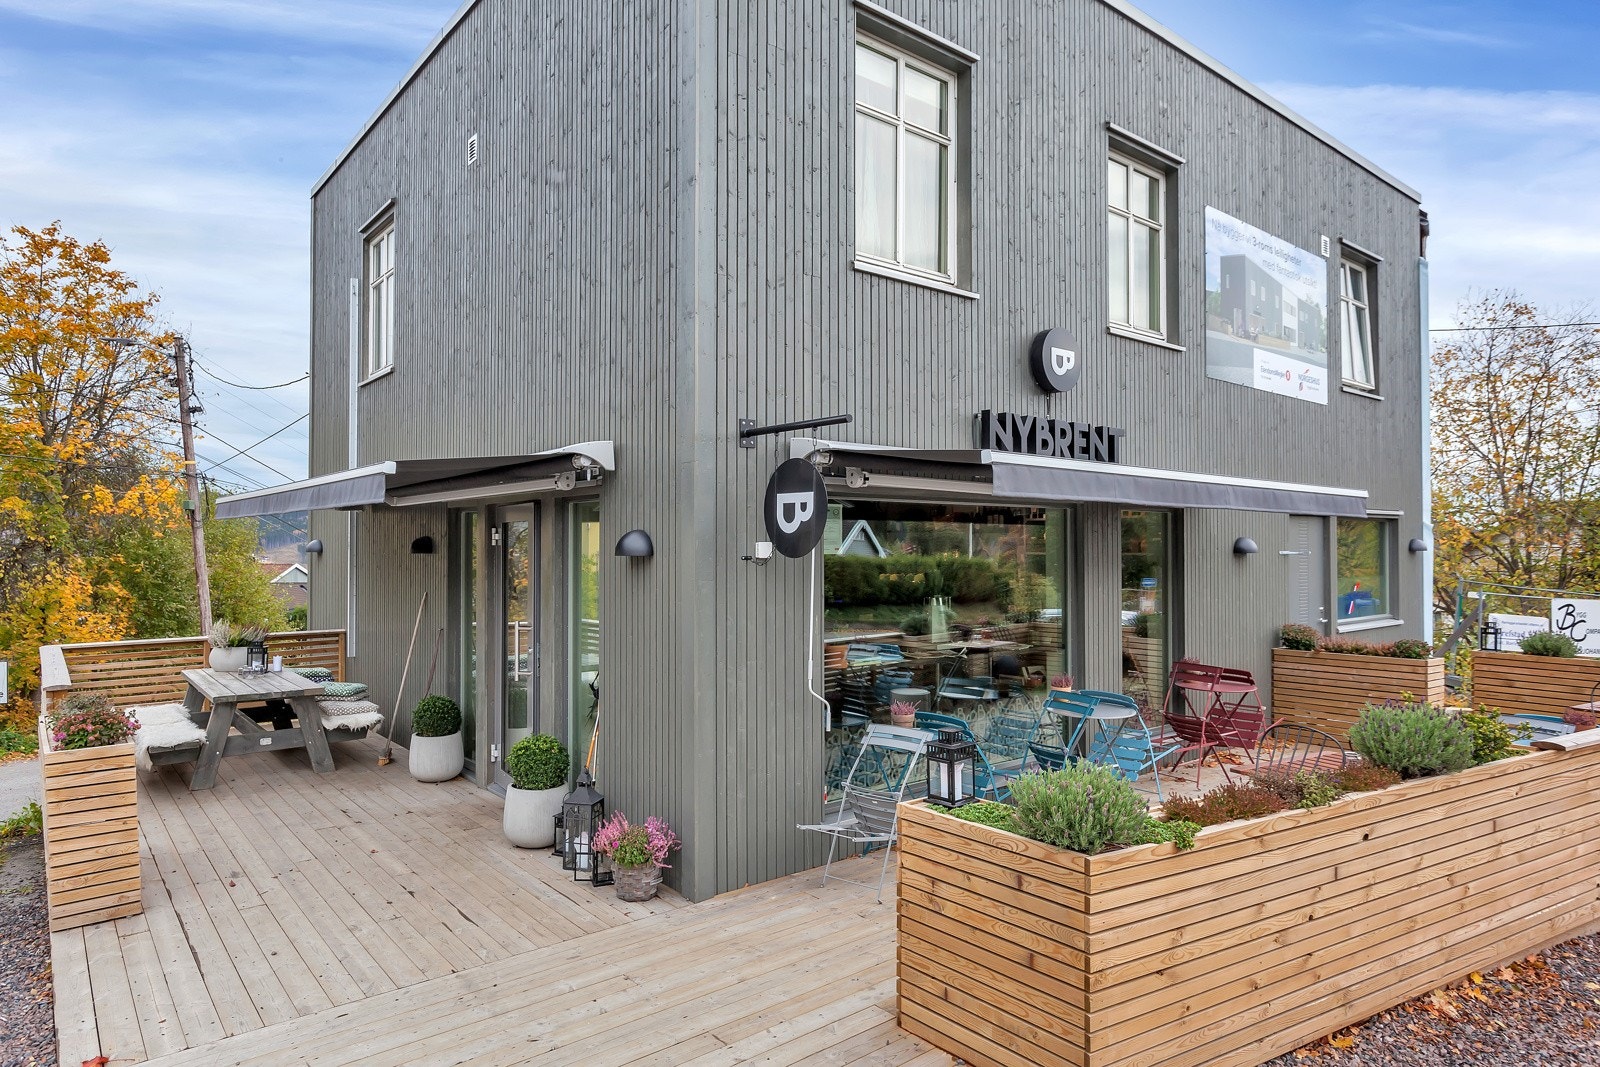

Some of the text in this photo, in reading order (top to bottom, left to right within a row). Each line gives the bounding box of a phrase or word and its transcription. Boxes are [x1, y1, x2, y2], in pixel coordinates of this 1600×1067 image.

[1252, 236, 1273, 255] 3-roms
[1051, 347, 1075, 376] B
[982, 410, 1126, 463] NYBRENT
[777, 492, 814, 534] B
